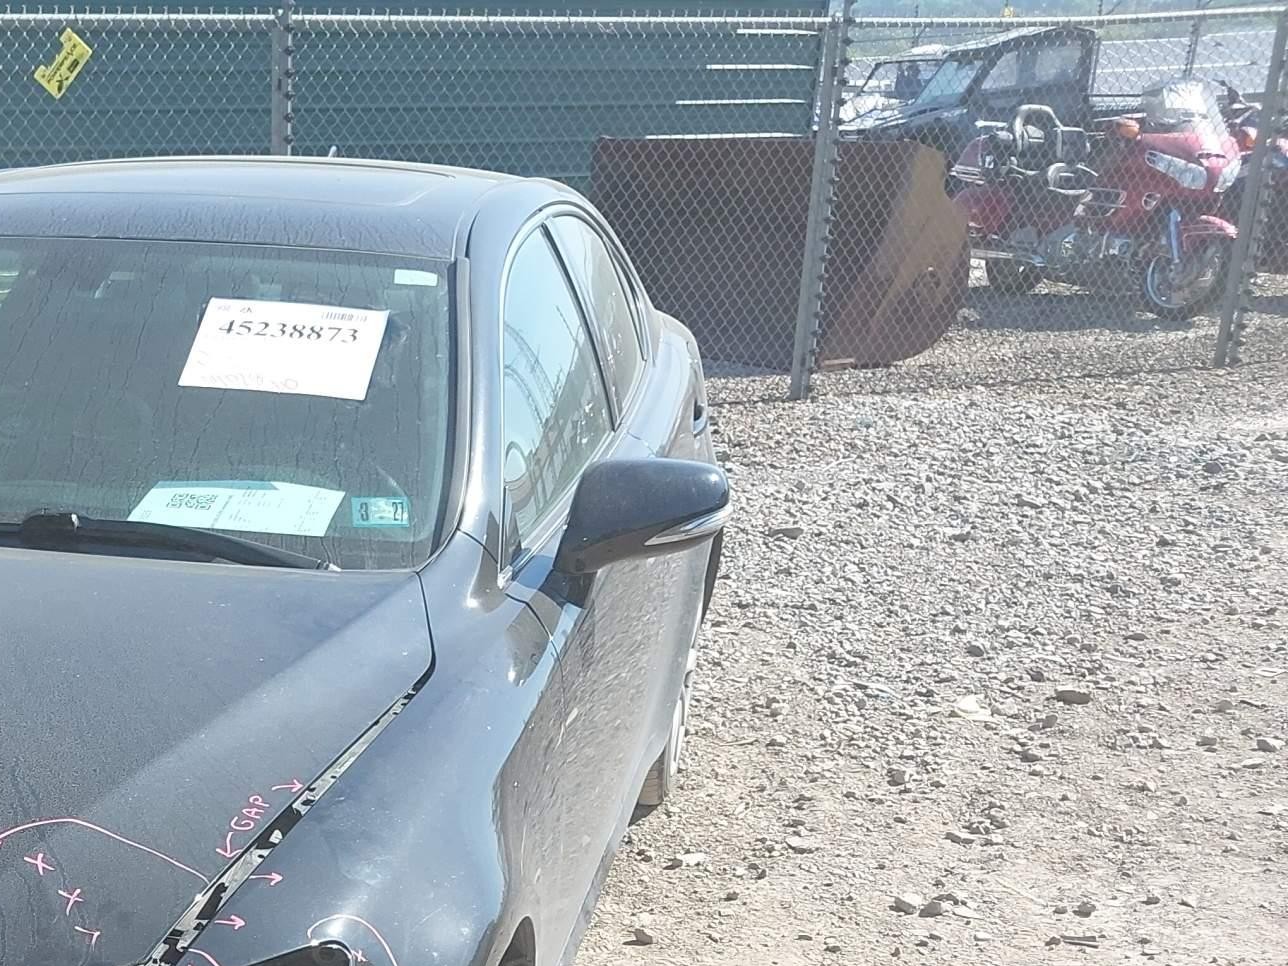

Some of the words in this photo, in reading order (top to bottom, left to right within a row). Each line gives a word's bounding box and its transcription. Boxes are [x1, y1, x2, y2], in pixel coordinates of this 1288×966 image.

[218, 319, 359, 344] 45238873
[359, 502, 369, 522] 3
[392, 501, 404, 522] 27
[230, 795, 270, 831] GAP
